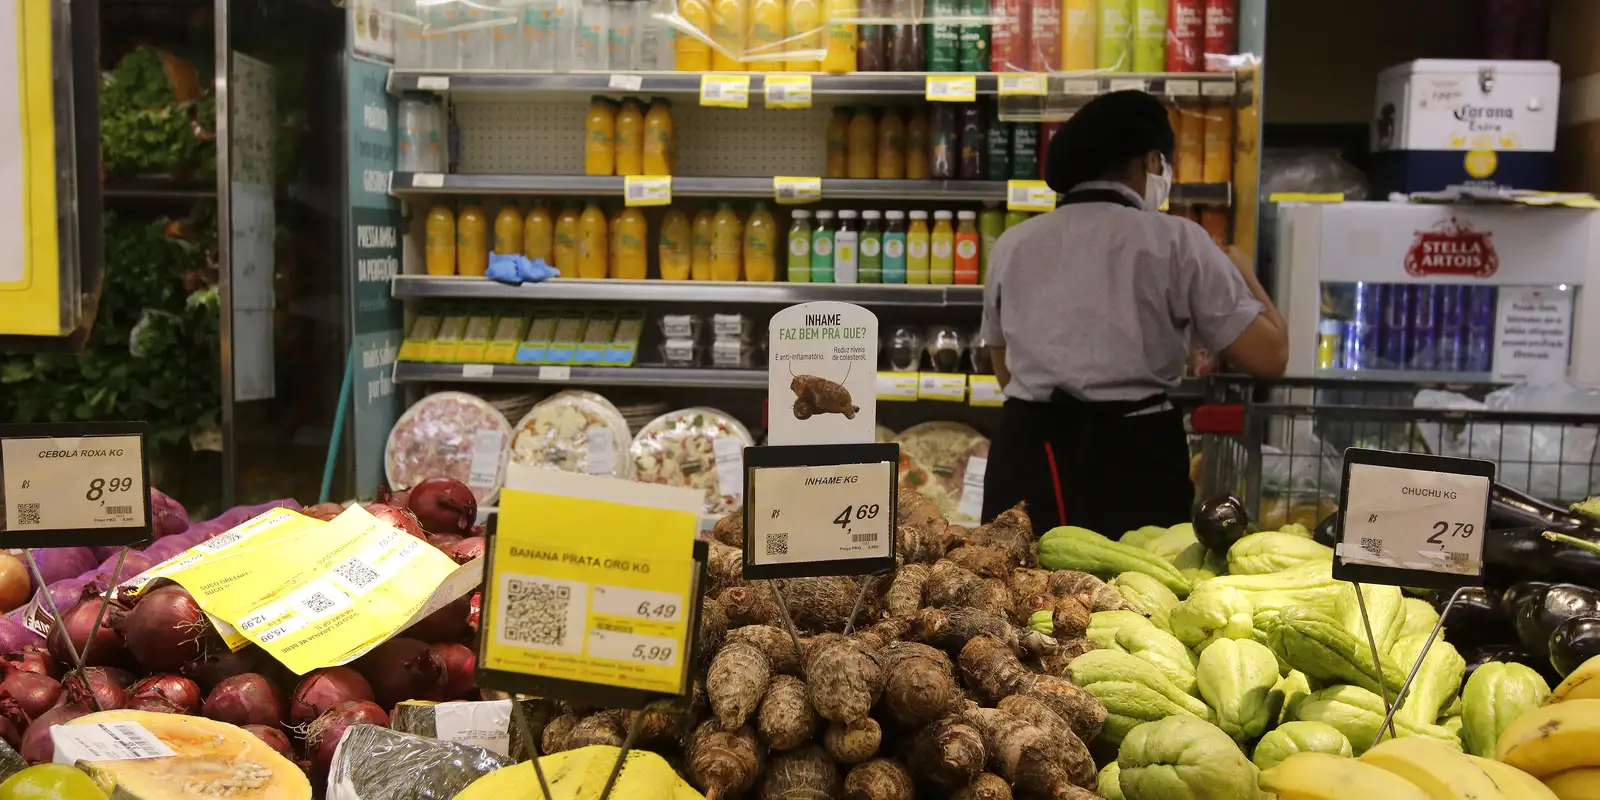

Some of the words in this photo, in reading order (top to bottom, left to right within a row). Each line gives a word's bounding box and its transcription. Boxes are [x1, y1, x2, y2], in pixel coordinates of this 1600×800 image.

[1453, 104, 1513, 121] Corona
[1422, 242, 1481, 254] STELLA
[1421, 255, 1482, 267] ARTOIS
[805, 314, 841, 326] INHAME
[780, 328, 796, 340] FAZ
[799, 328, 819, 340] BEM
[822, 327, 840, 339] PRA
[843, 327, 867, 339] QUE?
[38, 450, 78, 458] CEBOLA
[80, 449, 106, 457] ROXA
[109, 449, 124, 457] KG
[804, 477, 842, 486] INHAME
[844, 476, 858, 484] KG
[22, 480, 31, 489] R$
[86, 477, 132, 506] 8,99
[1401, 487, 1441, 498] CHUCHU
[1443, 491, 1457, 499] KG
[771, 509, 780, 519] R$
[833, 504, 879, 534] 4,69
[1368, 514, 1378, 523] R$
[1427, 521, 1474, 550] 2,79
[509, 547, 559, 562] BANANA
[562, 553, 600, 567] PRATA
[604, 559, 630, 571] ORG
[632, 562, 650, 573] KG
[200, 580, 219, 591] SUCO
[636, 600, 677, 619] 6,49
[241, 613, 267, 631] 12,99
[260, 626, 287, 643] 15,99
[632, 643, 672, 661] 5,99
